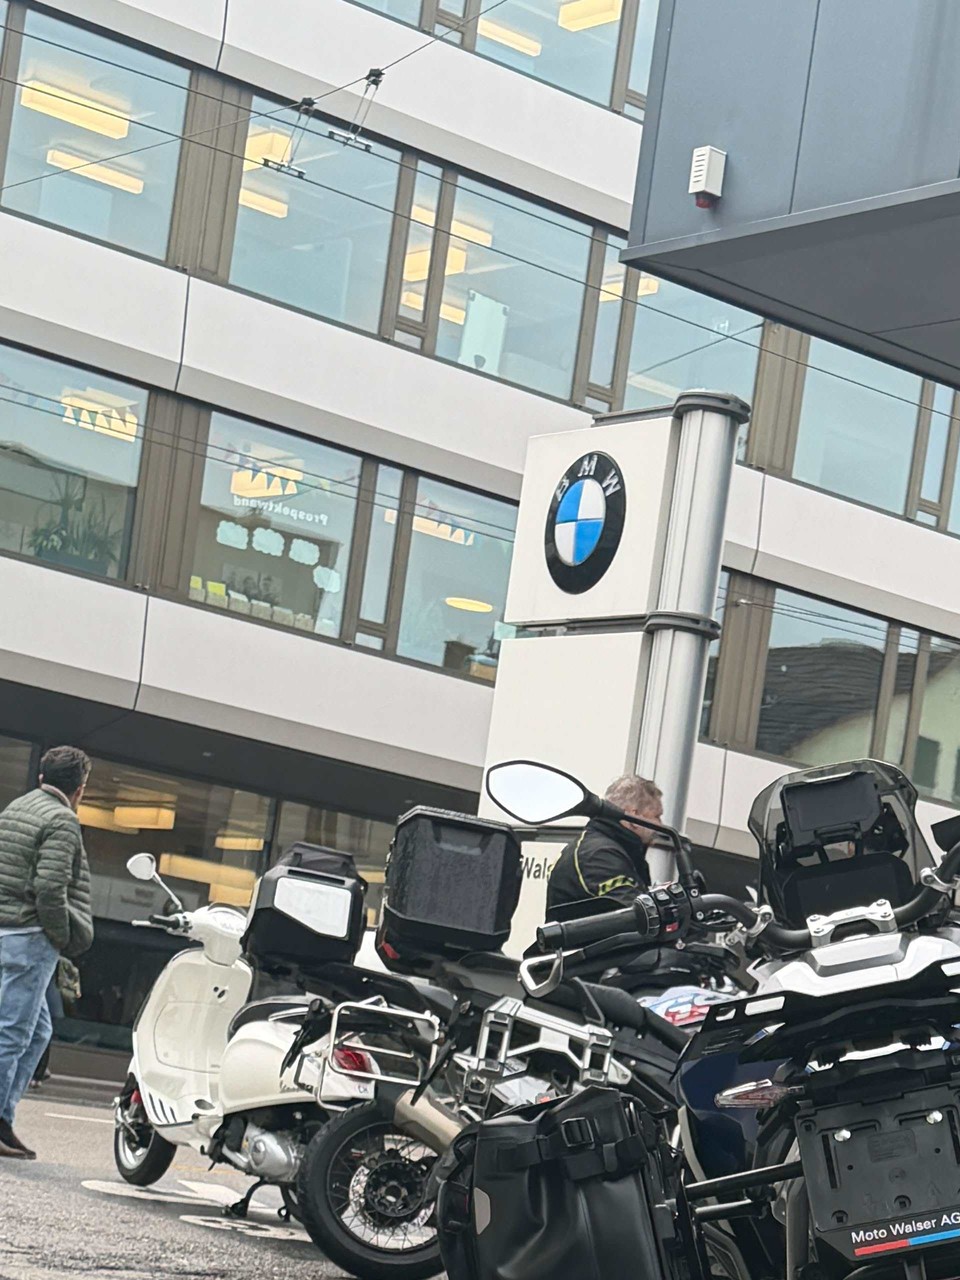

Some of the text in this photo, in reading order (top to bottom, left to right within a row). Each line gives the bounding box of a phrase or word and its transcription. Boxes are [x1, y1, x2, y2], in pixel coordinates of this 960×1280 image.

[555, 454, 621, 501] BMW
[851, 1228, 888, 1244] Moto
[889, 1219, 937, 1236] Walser
